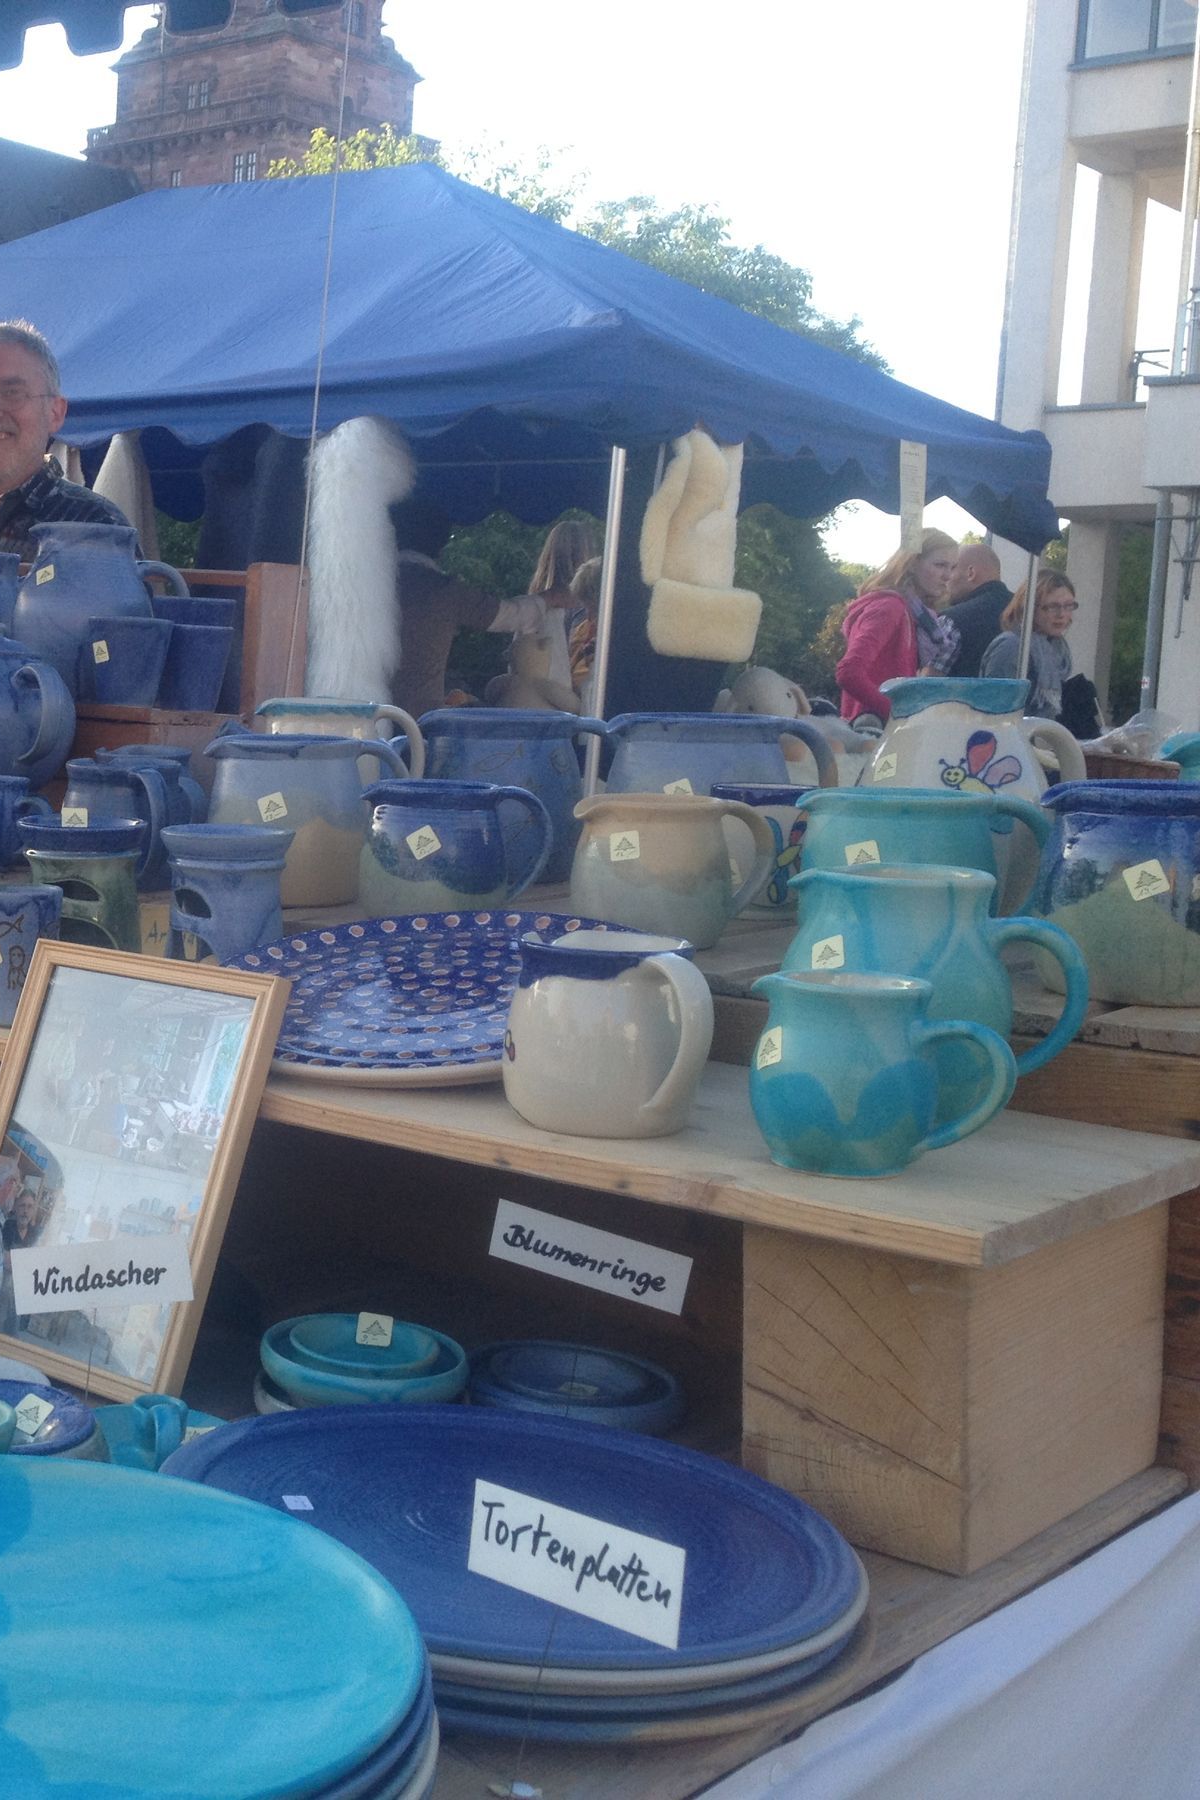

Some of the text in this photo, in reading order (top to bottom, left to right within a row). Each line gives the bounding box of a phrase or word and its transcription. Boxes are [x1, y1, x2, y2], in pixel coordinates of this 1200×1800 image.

[32, 1259, 167, 1296] Windascher
[502, 1224, 667, 1296] Blumenringe
[481, 1499, 672, 1609] Tortenplatten
